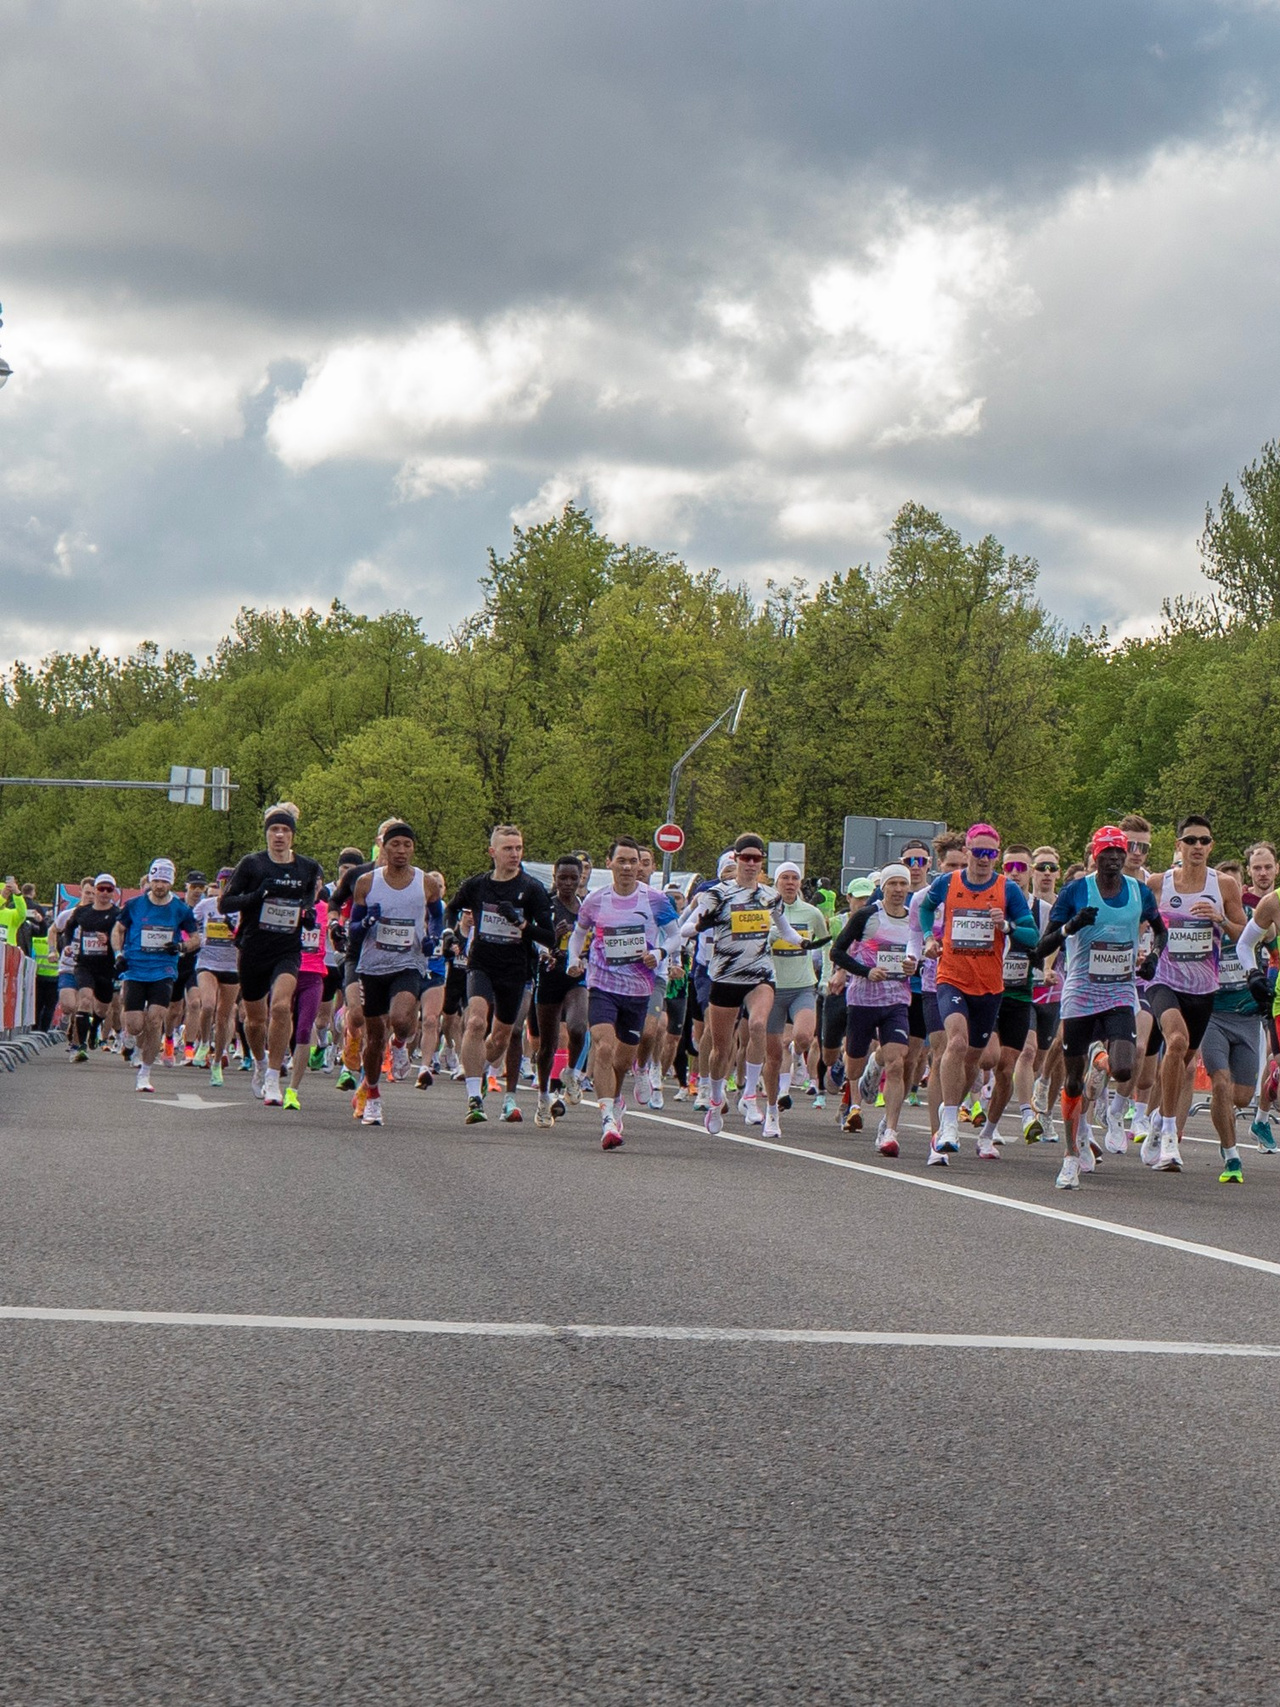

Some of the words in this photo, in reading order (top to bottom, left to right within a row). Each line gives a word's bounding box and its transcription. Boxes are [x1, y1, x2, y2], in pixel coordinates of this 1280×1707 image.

[267, 907, 295, 918] СУЩЕНЯ
[738, 913, 765, 923] СЕДОВА
[483, 914, 507, 926] ПАТРА
[953, 919, 995, 930] ГРИГОРЬЕВ
[382, 927, 409, 937] БУРЦЕВ
[1169, 930, 1212, 943] АХМАДЕЕВ
[605, 936, 645, 949] ЧЕРТЫКОВ
[1093, 953, 1131, 964] MNANGAT
